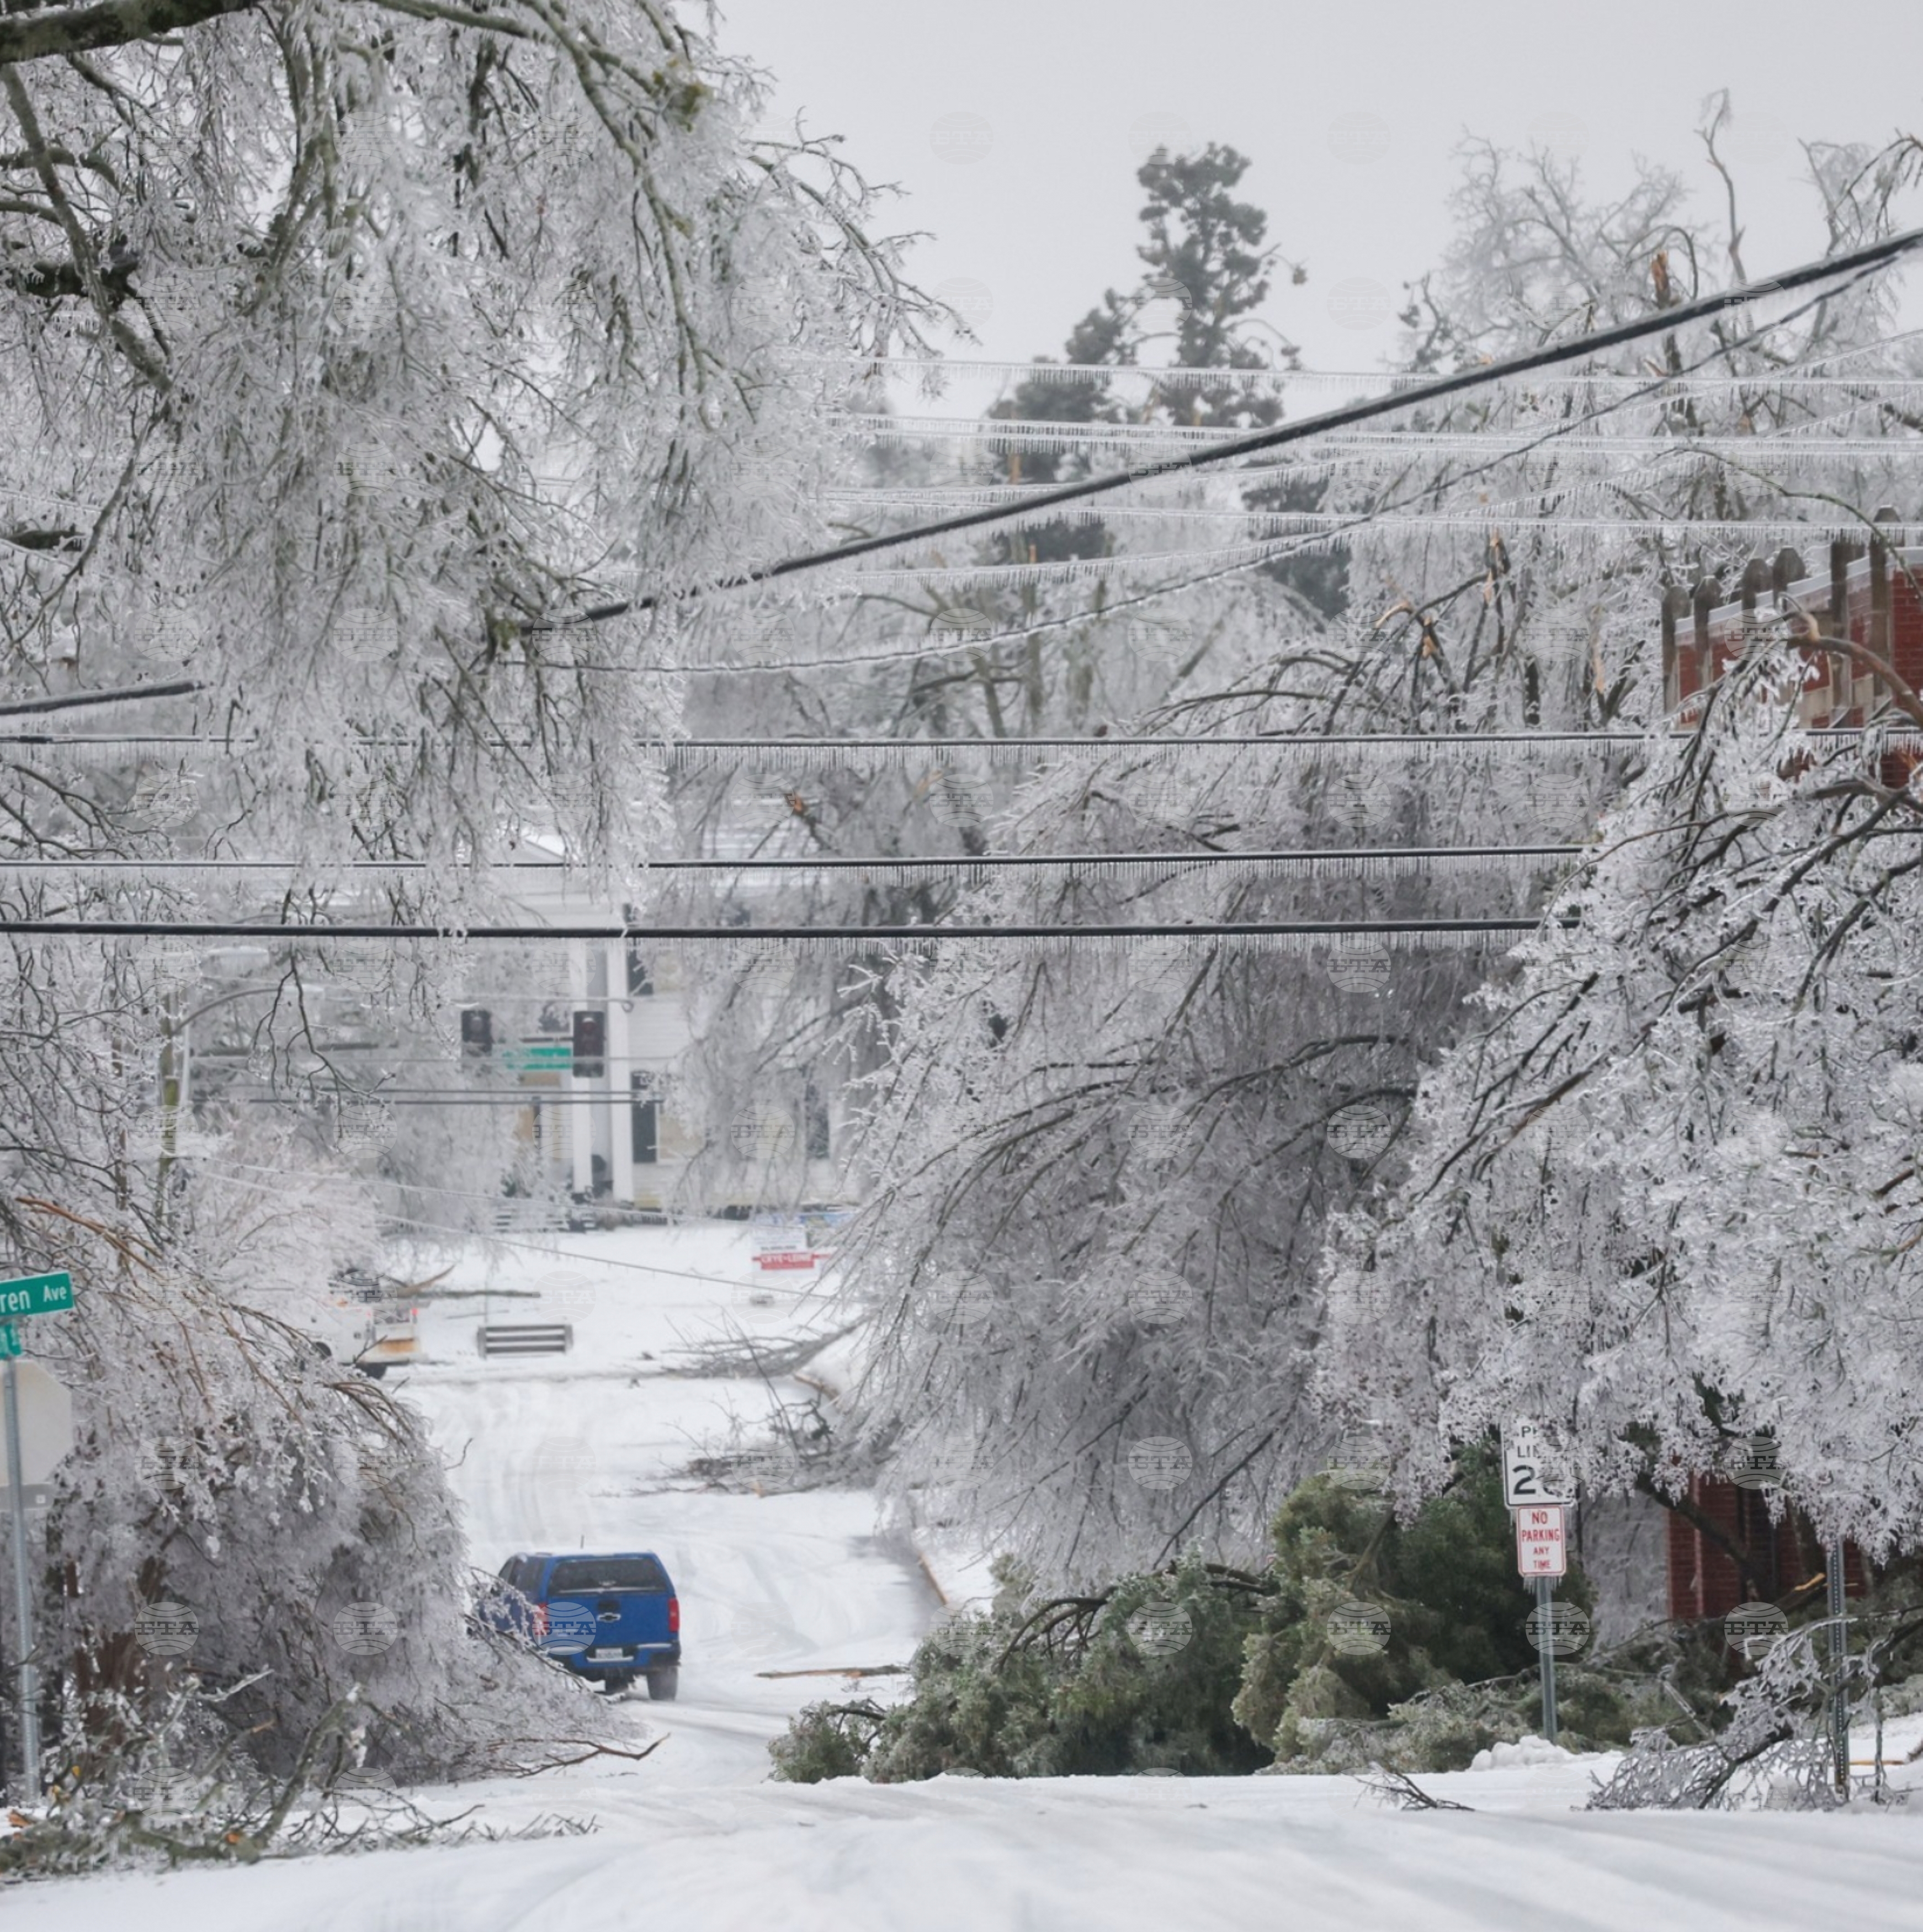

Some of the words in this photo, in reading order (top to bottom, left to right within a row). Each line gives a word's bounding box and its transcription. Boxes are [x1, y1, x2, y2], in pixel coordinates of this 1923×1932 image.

[43, 1284, 67, 1302] Ave
[1532, 1511, 1548, 1525] NO
[1522, 1528, 1560, 1542] PARKING
[1533, 1560, 1550, 1569] TIME
